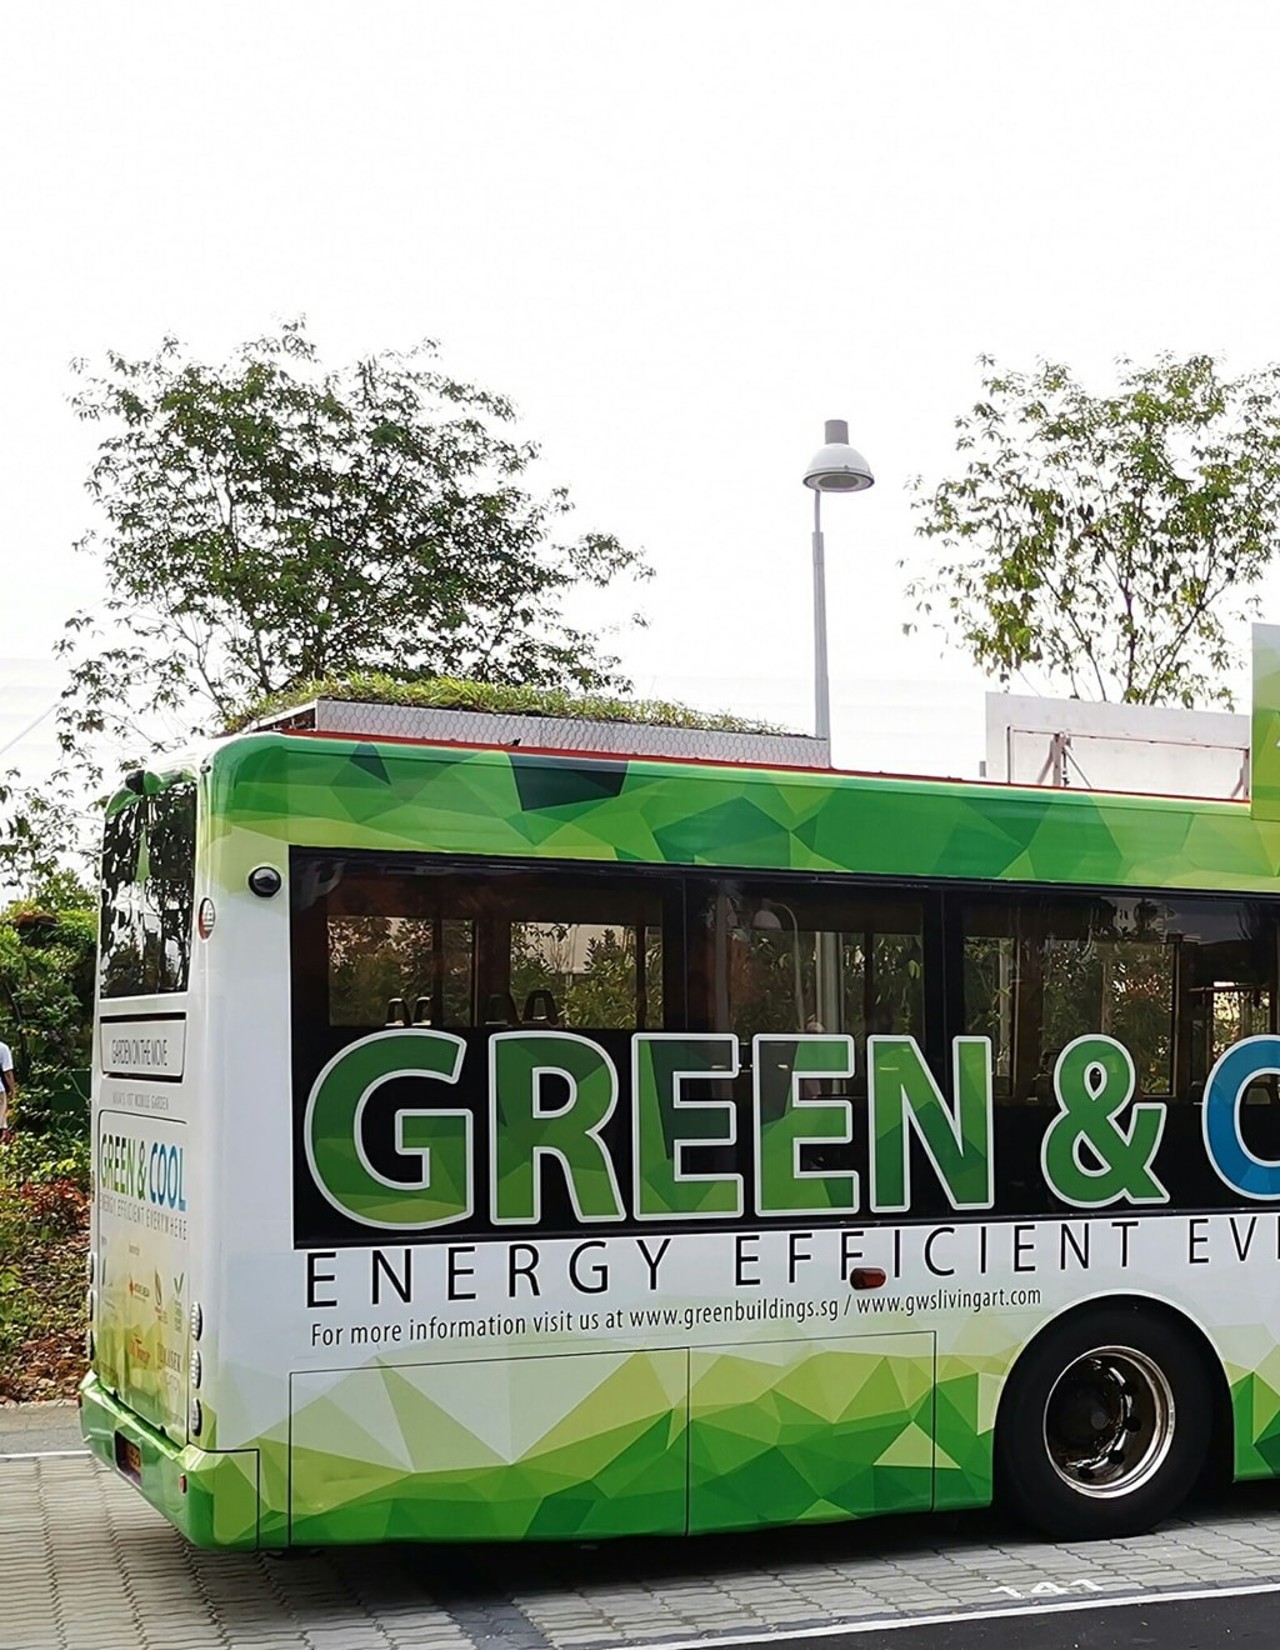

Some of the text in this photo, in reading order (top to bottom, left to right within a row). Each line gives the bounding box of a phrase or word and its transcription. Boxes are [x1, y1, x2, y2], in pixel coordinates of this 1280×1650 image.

[304, 1028, 996, 1230] GREEN
[1041, 1033, 1170, 1208] &
[101, 1133, 187, 1212] GREEN & COOL
[307, 1238, 671, 1309] ENERGY
[735, 1221, 1139, 1286] EFFICIENT
[311, 1287, 1041, 1346] For more information visit us at www.greenbuildings.sg / www.gwslivingart.com
[990, 1579, 1103, 1599] 141
